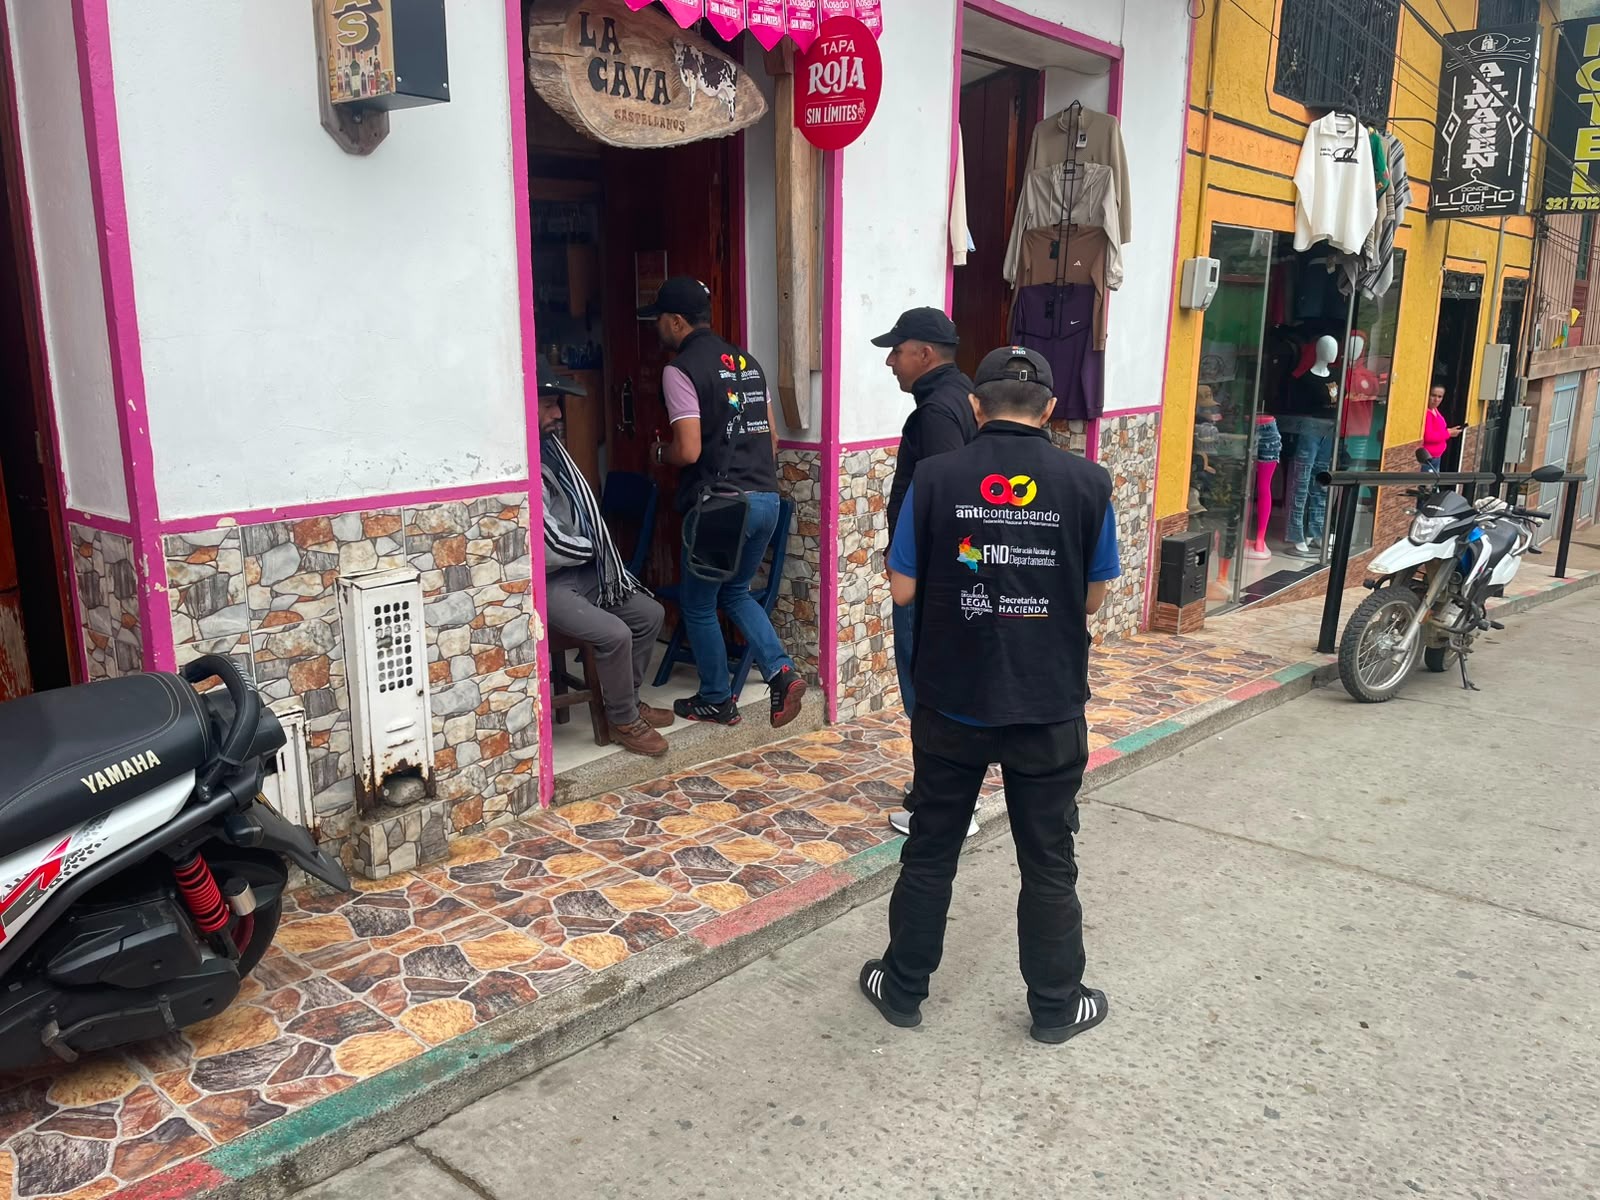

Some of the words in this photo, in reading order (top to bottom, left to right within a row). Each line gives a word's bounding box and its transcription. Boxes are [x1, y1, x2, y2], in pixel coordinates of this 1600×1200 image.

[578, 11, 621, 55] LA
[820, 40, 856, 55] TAPA
[587, 57, 671, 105] CAVA
[807, 56, 867, 96] ROJA
[614, 109, 685, 132] CASTELLANOS
[806, 108, 821, 124] SIN
[823, 103, 857, 122] LÍMITES
[1435, 190, 1515, 206] LUCHO
[1545, 197, 1568, 210] 321
[1460, 204, 1484, 212] STORE
[955, 507, 1060, 522] anticontrabando
[983, 544, 1009, 564] FND
[961, 598, 992, 608] LEGAL
[999, 595, 1038, 605] Secretaría
[1039, 597, 1049, 605] de
[998, 604, 1048, 614] HACIENDA
[80, 750, 161, 794] YAMAHA
